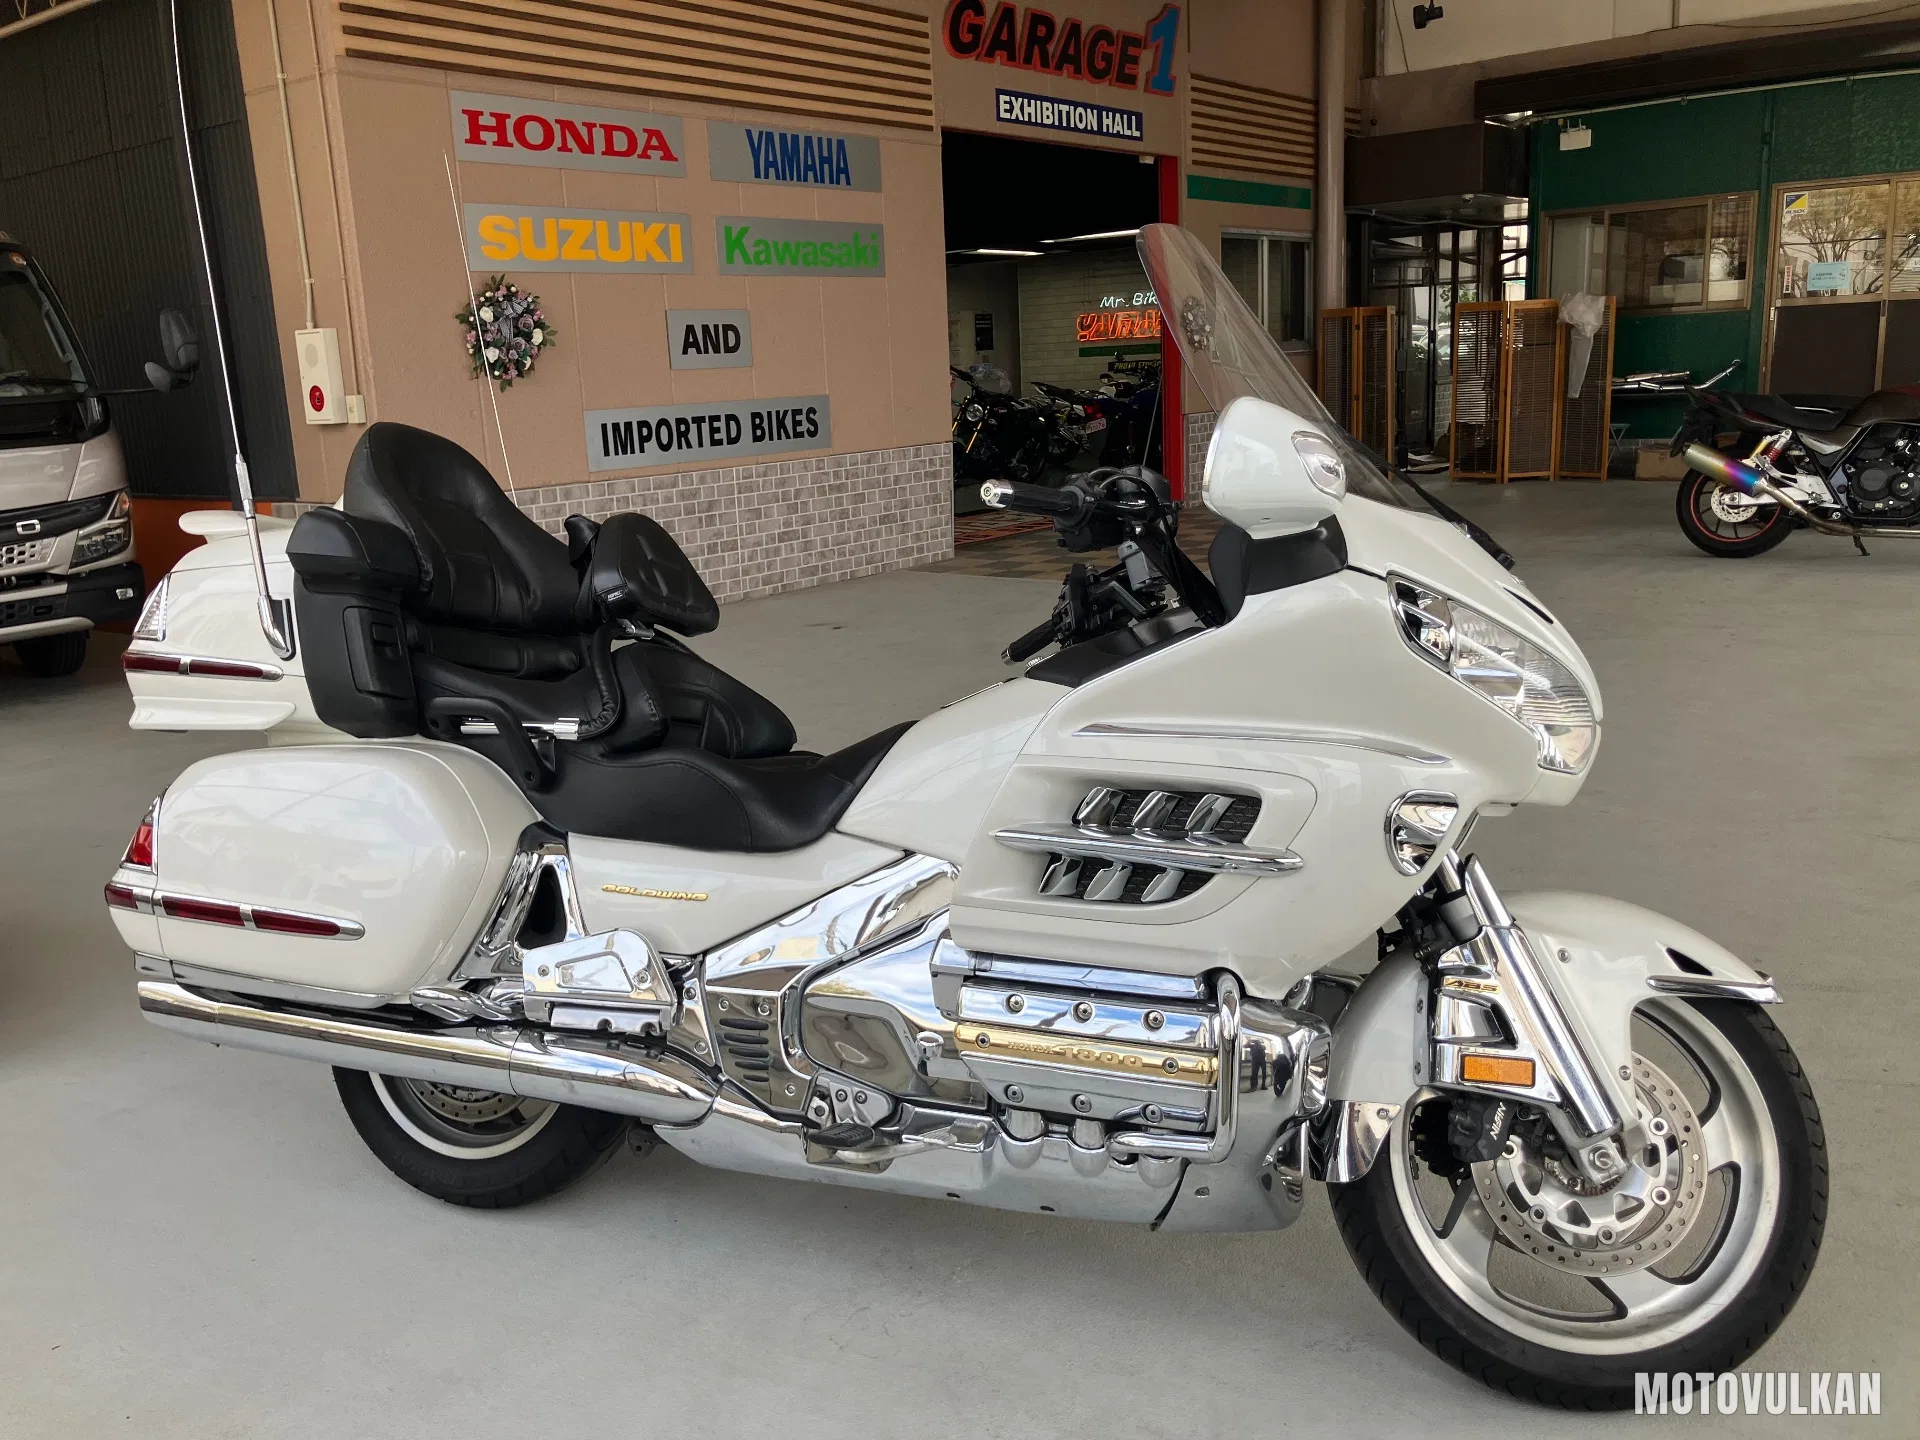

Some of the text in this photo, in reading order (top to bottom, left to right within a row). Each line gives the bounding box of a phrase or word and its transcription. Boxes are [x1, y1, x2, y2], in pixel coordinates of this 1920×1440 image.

[943, 0, 1146, 90] GARAGE
[462, 108, 678, 162] HONDA
[999, 94, 1141, 138] EXHIBITION HALL
[745, 128, 851, 186] YAMAHA
[478, 215, 683, 263] SUZUKI
[723, 225, 879, 268] Kawasaki
[681, 323, 741, 355] AND
[600, 406, 819, 457] IMPORTED BIKES
[601, 884, 709, 901] GOLDWING
[1445, 979, 1498, 991] ABS
[1007, 1041, 1143, 1067] HONDA 1800
